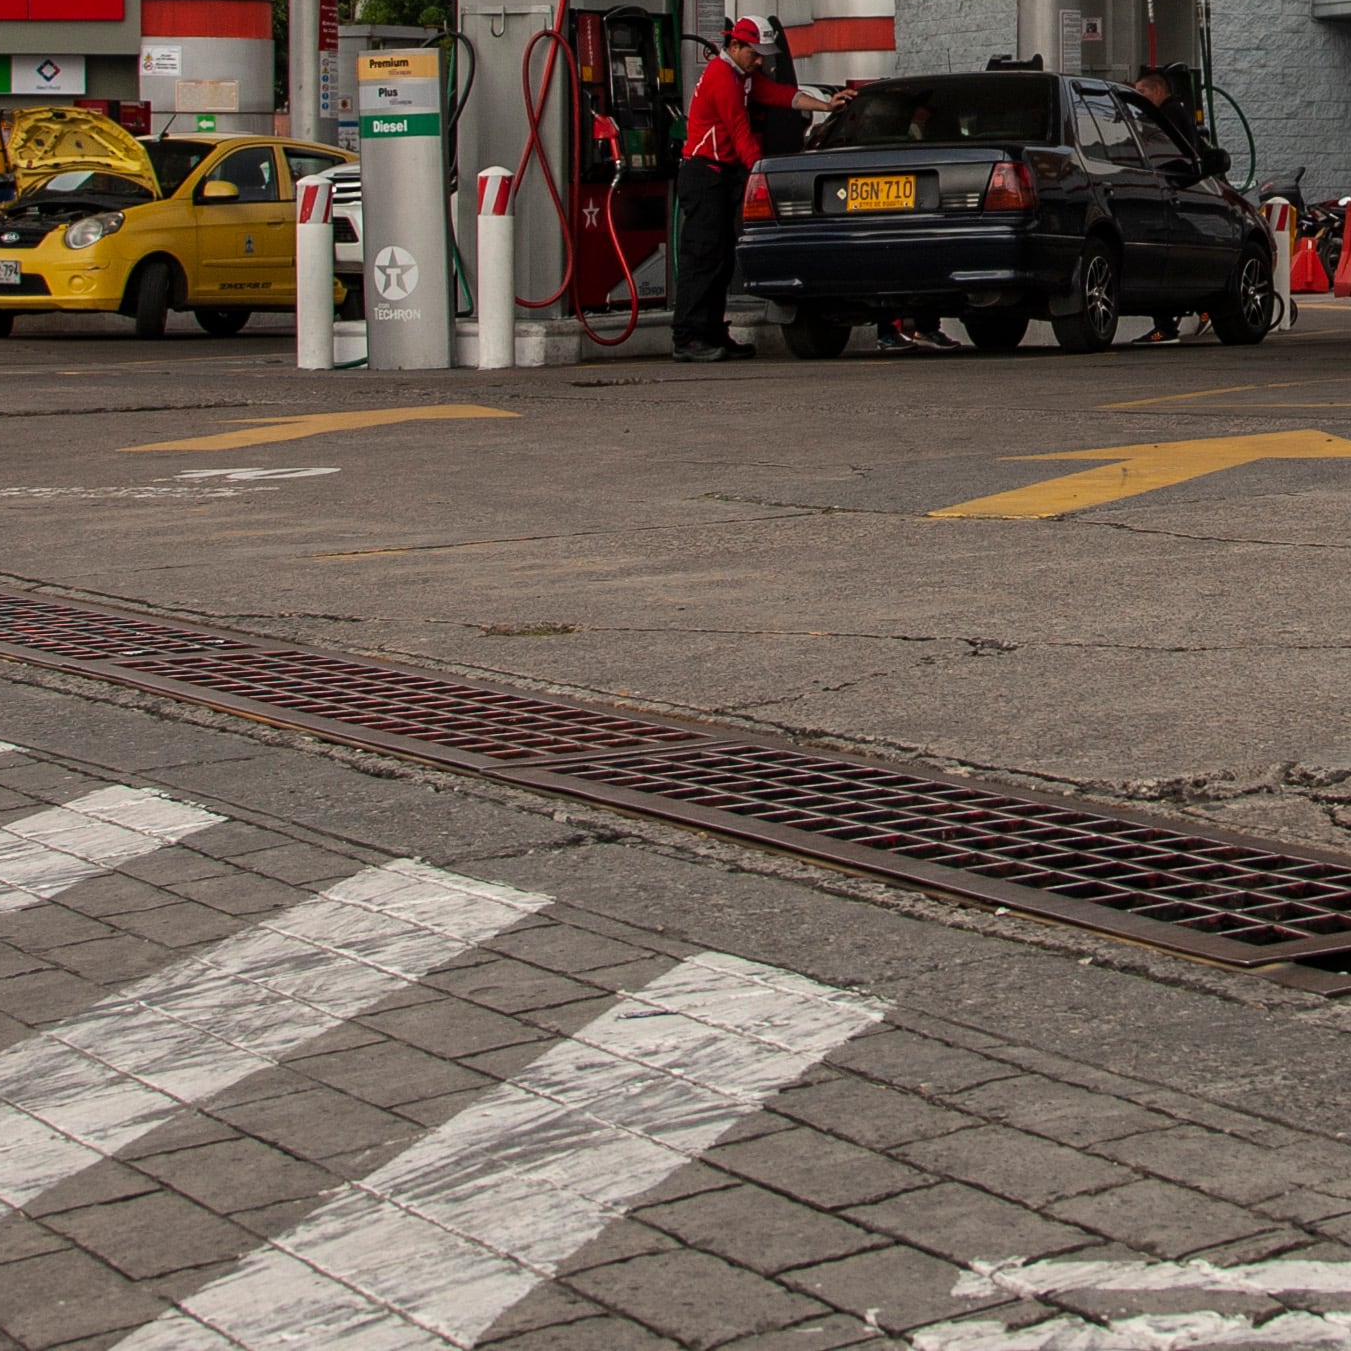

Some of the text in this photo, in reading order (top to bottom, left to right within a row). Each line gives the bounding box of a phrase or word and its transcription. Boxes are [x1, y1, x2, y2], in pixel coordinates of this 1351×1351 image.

[369, 53, 409, 68] Premium
[378, 87, 398, 97] Plus
[372, 119, 408, 133] Diesel
[884, 180, 913, 199] 710
[374, 307, 421, 322] TECHRON
